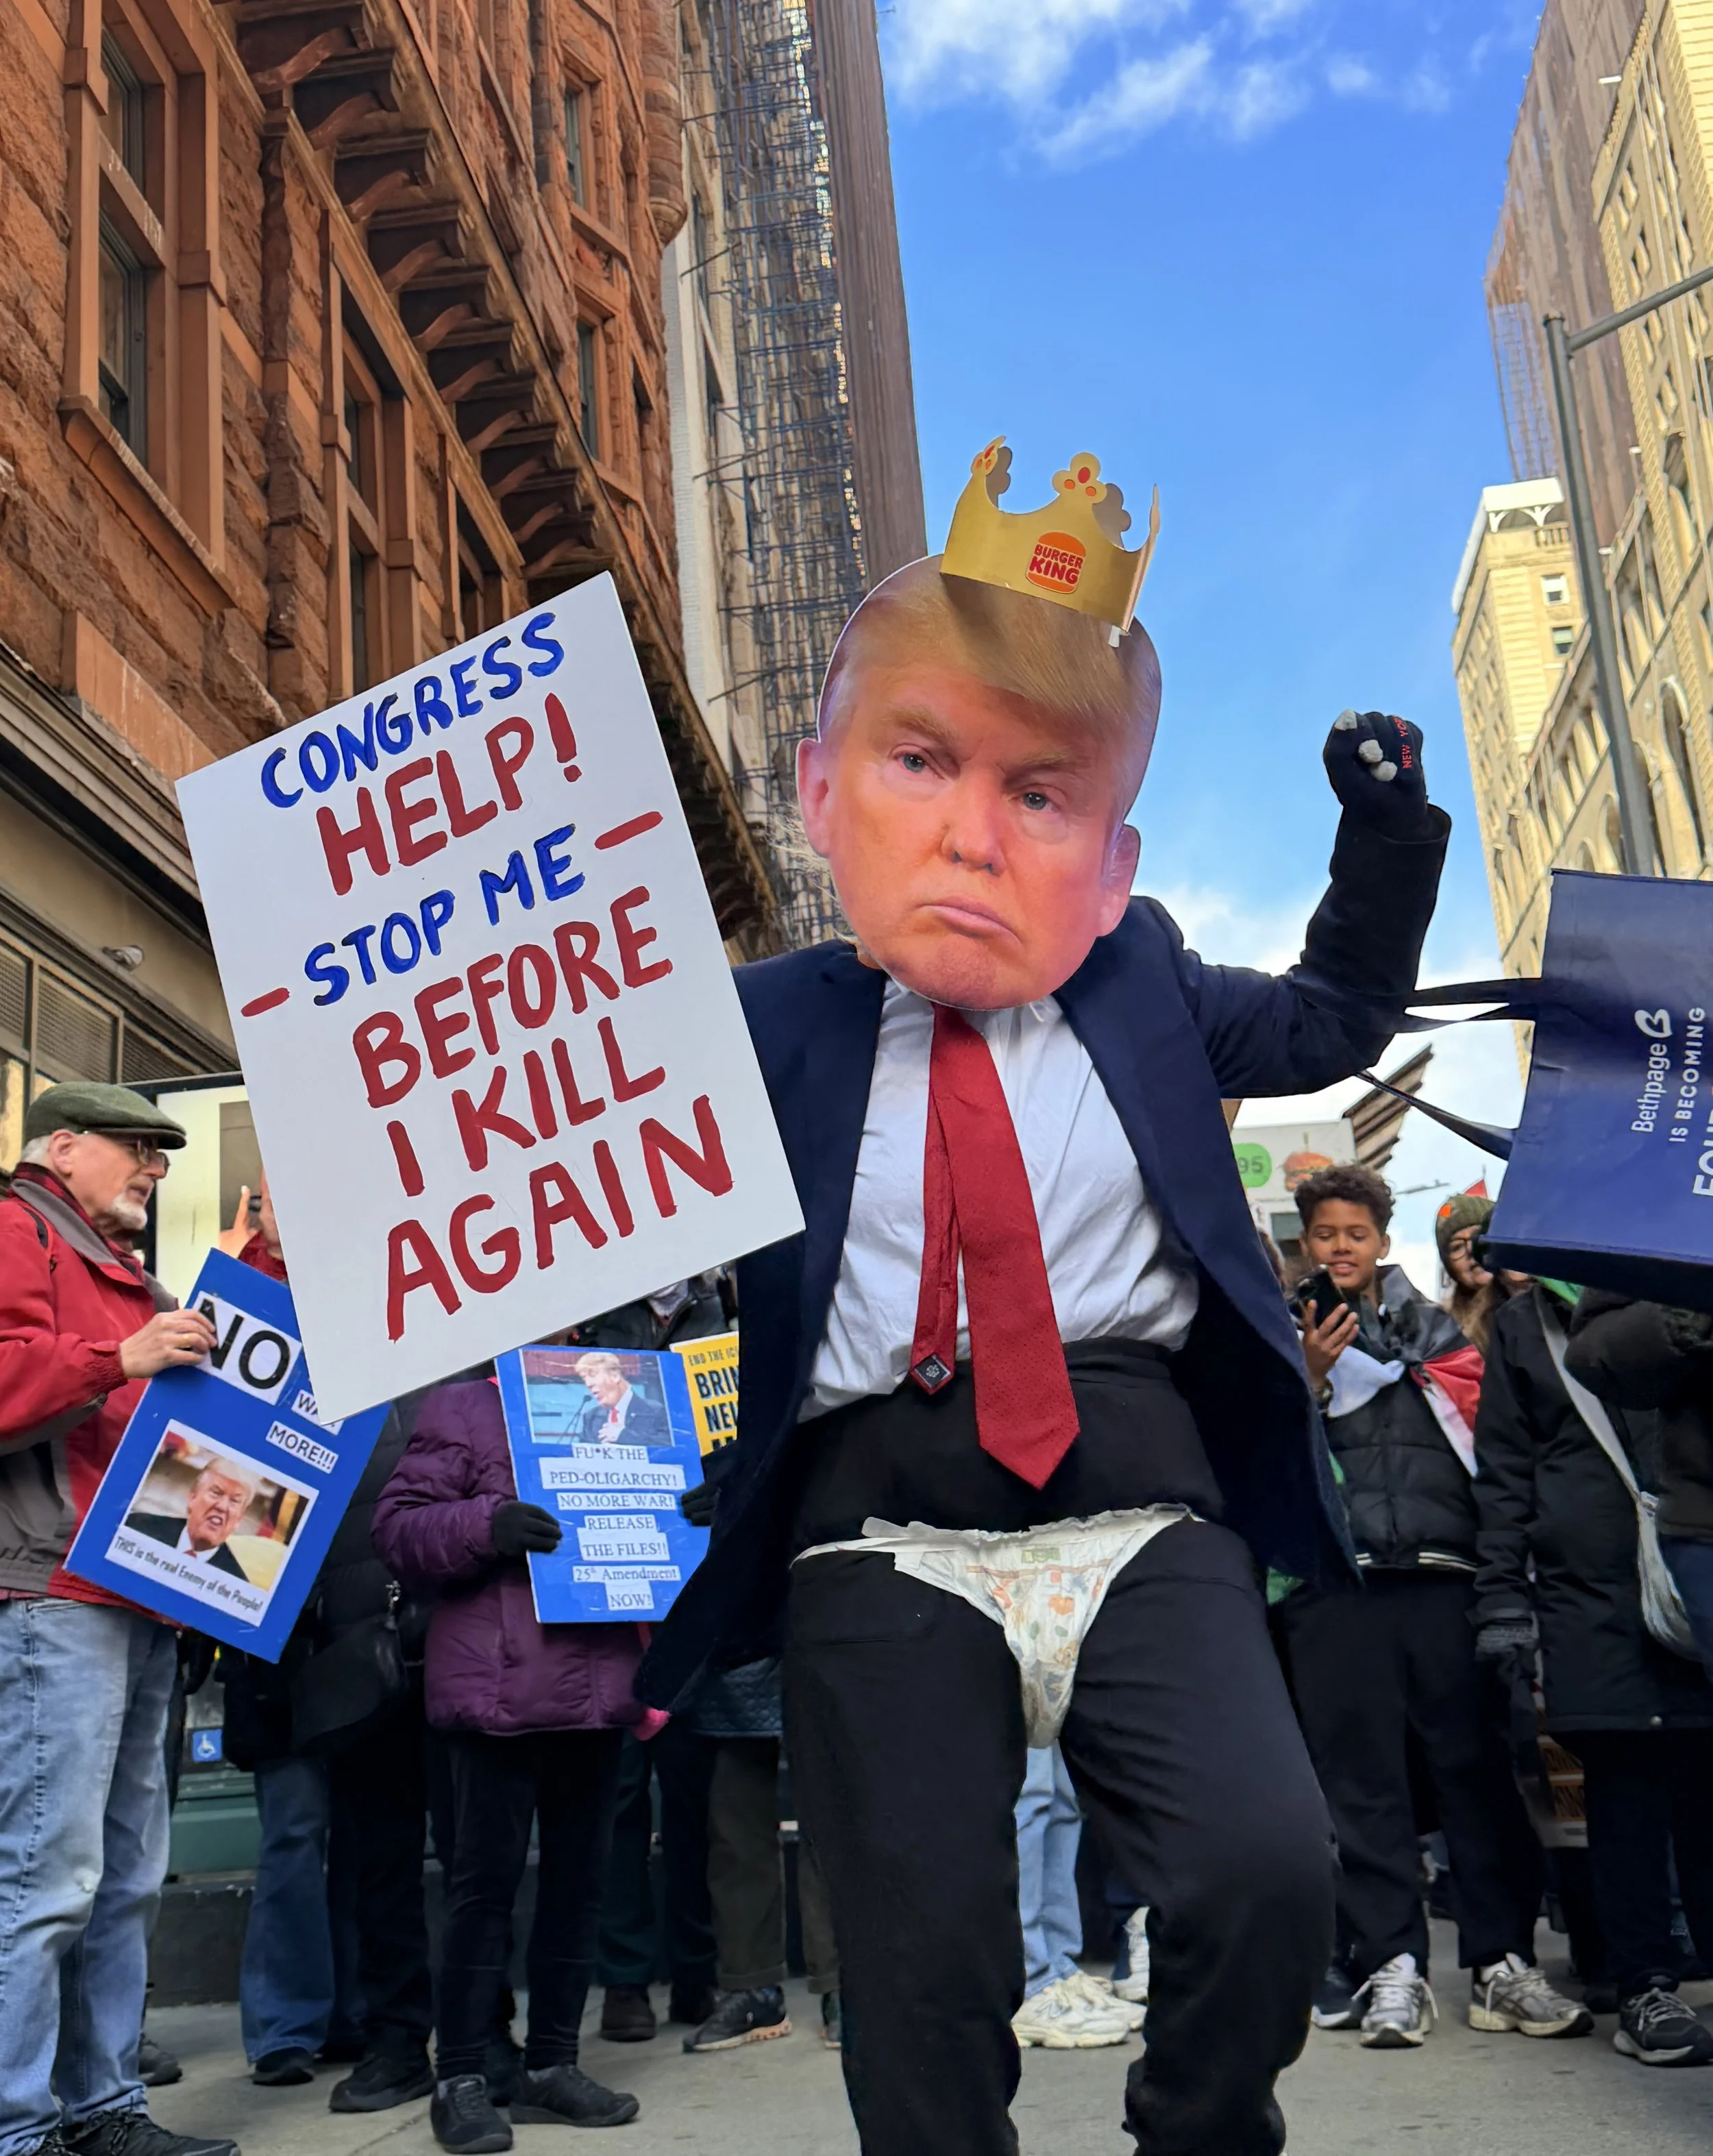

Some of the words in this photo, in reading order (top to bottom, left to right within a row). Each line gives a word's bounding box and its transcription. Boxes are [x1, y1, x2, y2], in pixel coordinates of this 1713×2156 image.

[1029, 555, 1080, 585] KING
[1034, 543, 1083, 569] BURGER
[261, 613, 564, 808] CONGRESS
[1402, 744, 1412, 769] NEW
[317, 694, 581, 895] HELP!
[305, 890, 455, 1005] STOP
[480, 825, 584, 926] ME
[353, 886, 672, 1108] BEFORE
[1675, 1007, 1705, 1120] BECOMING
[1631, 1043, 1670, 1132] Bethpage
[387, 1121, 424, 1197] I
[452, 1017, 665, 1171] KILL
[1668, 1127, 1688, 1142] IS
[387, 1096, 732, 1340] AGAIN
[199, 1298, 291, 1390] NO
[269, 1425, 336, 1470] MORE!!!
[617, 1447, 646, 1460] THE
[550, 1471, 678, 1486] PED-OLIGARCHY!
[559, 1495, 582, 1508] NO
[586, 1494, 631, 1508] MORE
[633, 1495, 673, 1508] WAR!
[587, 1517, 654, 1530] RELEASE
[582, 1543, 614, 1556] THE
[144, 1550, 160, 1565] the
[178, 1567, 206, 1589] Enemy
[217, 1584, 232, 1599] the
[602, 1567, 677, 1581] Amendment
[610, 1593, 652, 1608] NOW!
